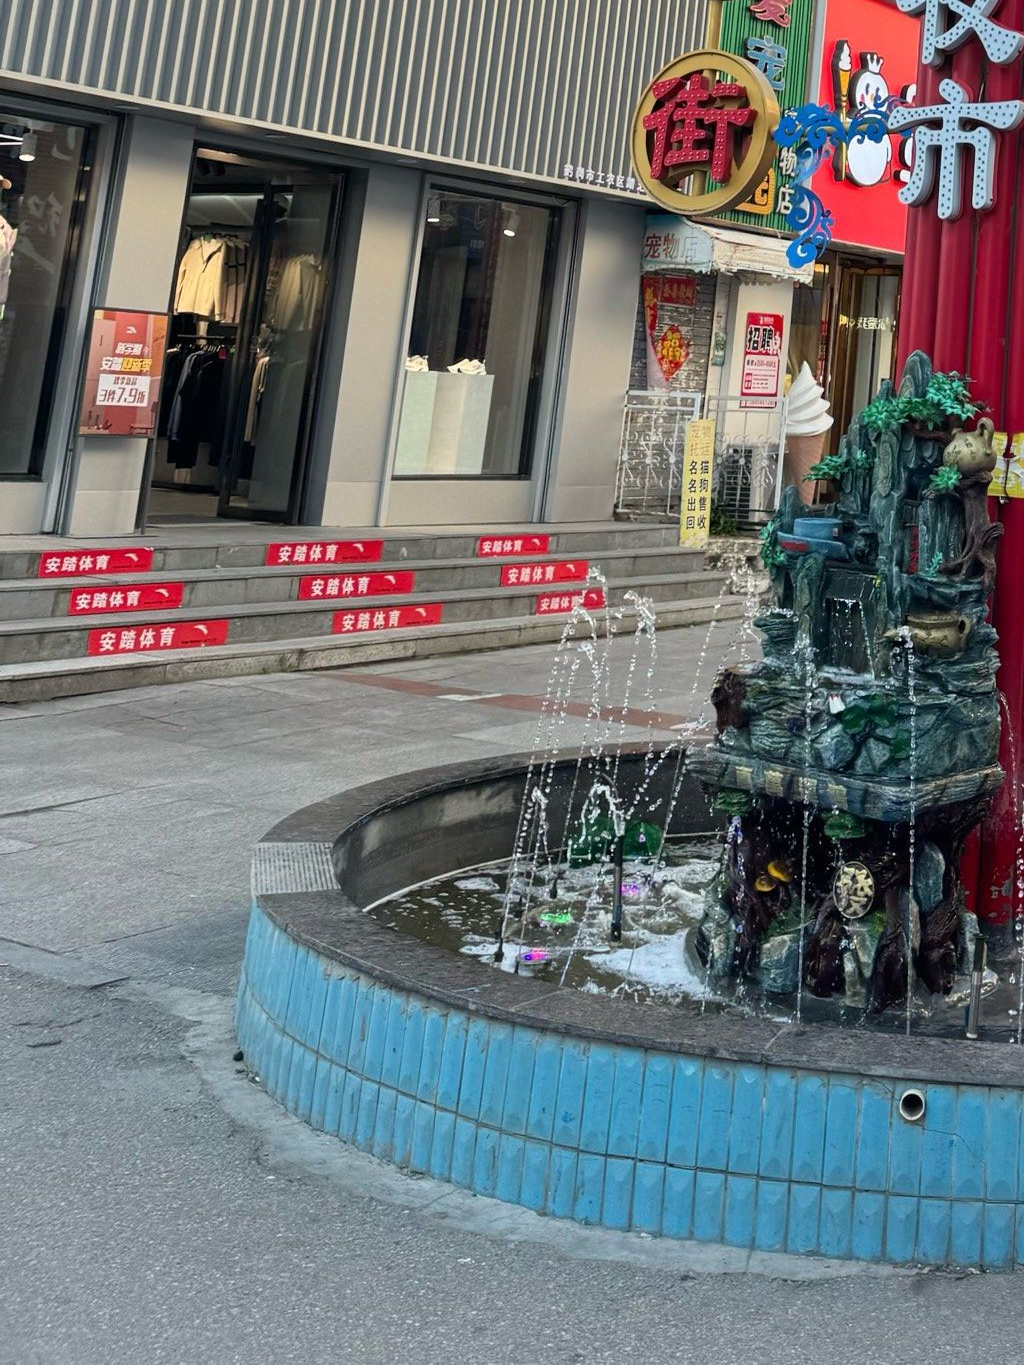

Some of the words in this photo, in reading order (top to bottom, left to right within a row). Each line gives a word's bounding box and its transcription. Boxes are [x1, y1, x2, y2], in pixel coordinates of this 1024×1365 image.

[643, 233, 698, 259] 宠物店
[278, 541, 338, 563] 安踏体育
[482, 539, 523, 554] 安踏体育
[45, 554, 111, 574] 安踏体育
[507, 565, 556, 584] 安踏体育
[310, 575, 371, 597] 安踏体育
[75, 590, 141, 610] 安踏体育
[342, 609, 402, 632] 安踏体育
[99, 627, 176, 652] 安踏体育
